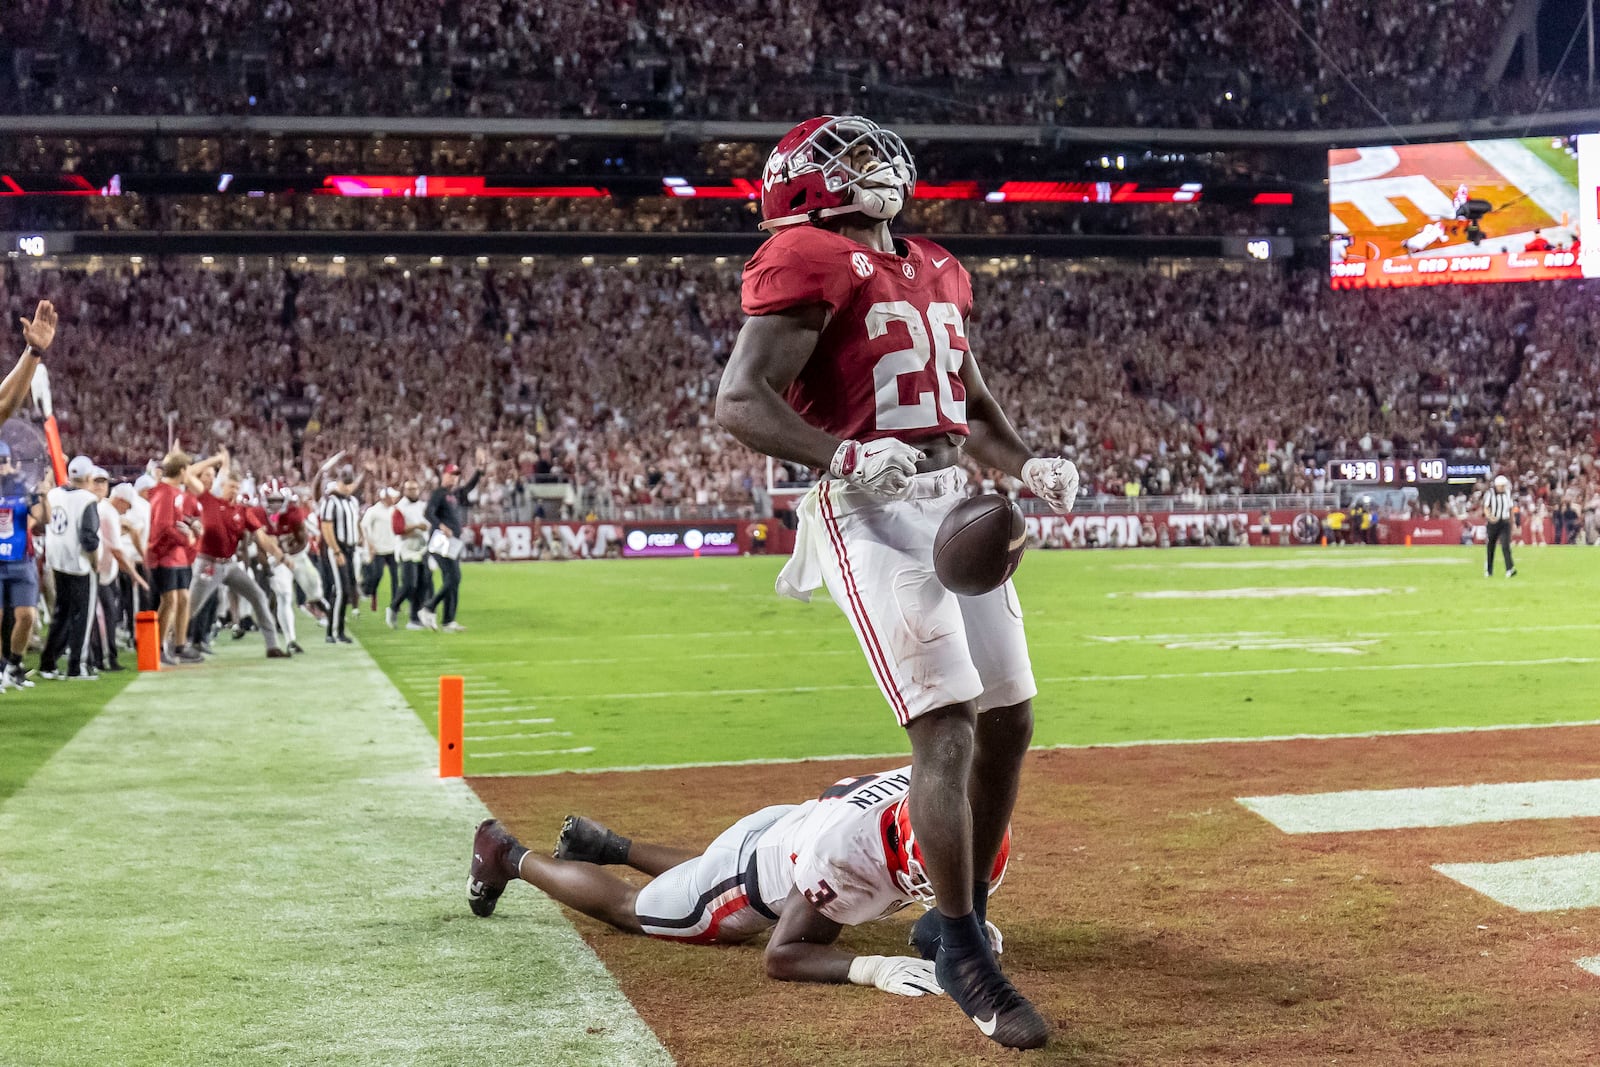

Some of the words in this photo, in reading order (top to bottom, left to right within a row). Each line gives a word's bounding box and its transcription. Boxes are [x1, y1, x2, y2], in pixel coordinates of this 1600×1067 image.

[20, 236, 44, 256] 40
[1247, 241, 1269, 259] 40
[852, 251, 874, 278] SEC
[865, 300, 967, 430] 26
[1340, 462, 1377, 480] 4:39
[1383, 466, 1394, 482] 3
[1405, 466, 1416, 482] 5
[1420, 461, 1443, 479] 40
[1447, 465, 1491, 475] NISSAN
[1024, 515, 1150, 546] RIMSON
[847, 773, 910, 810] ALLEN
[804, 879, 838, 908] 3
